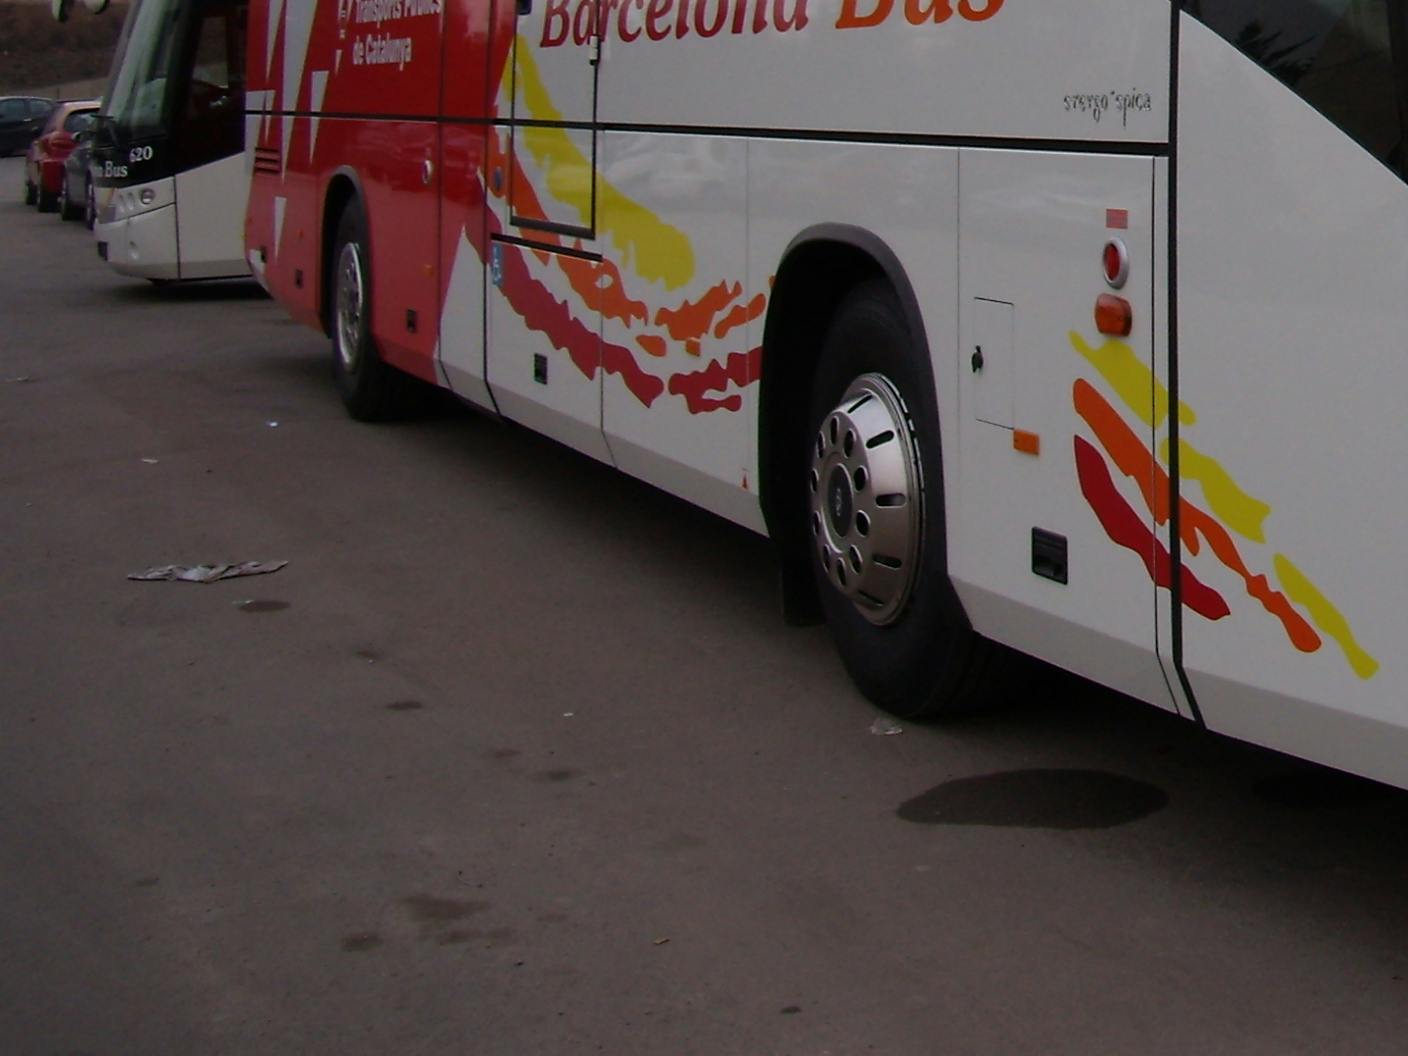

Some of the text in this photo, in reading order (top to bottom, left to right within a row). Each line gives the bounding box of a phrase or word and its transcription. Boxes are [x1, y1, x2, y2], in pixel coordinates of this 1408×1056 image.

[352, 32, 412, 72] de Catalunya
[105, 160, 128, 178] Bus
